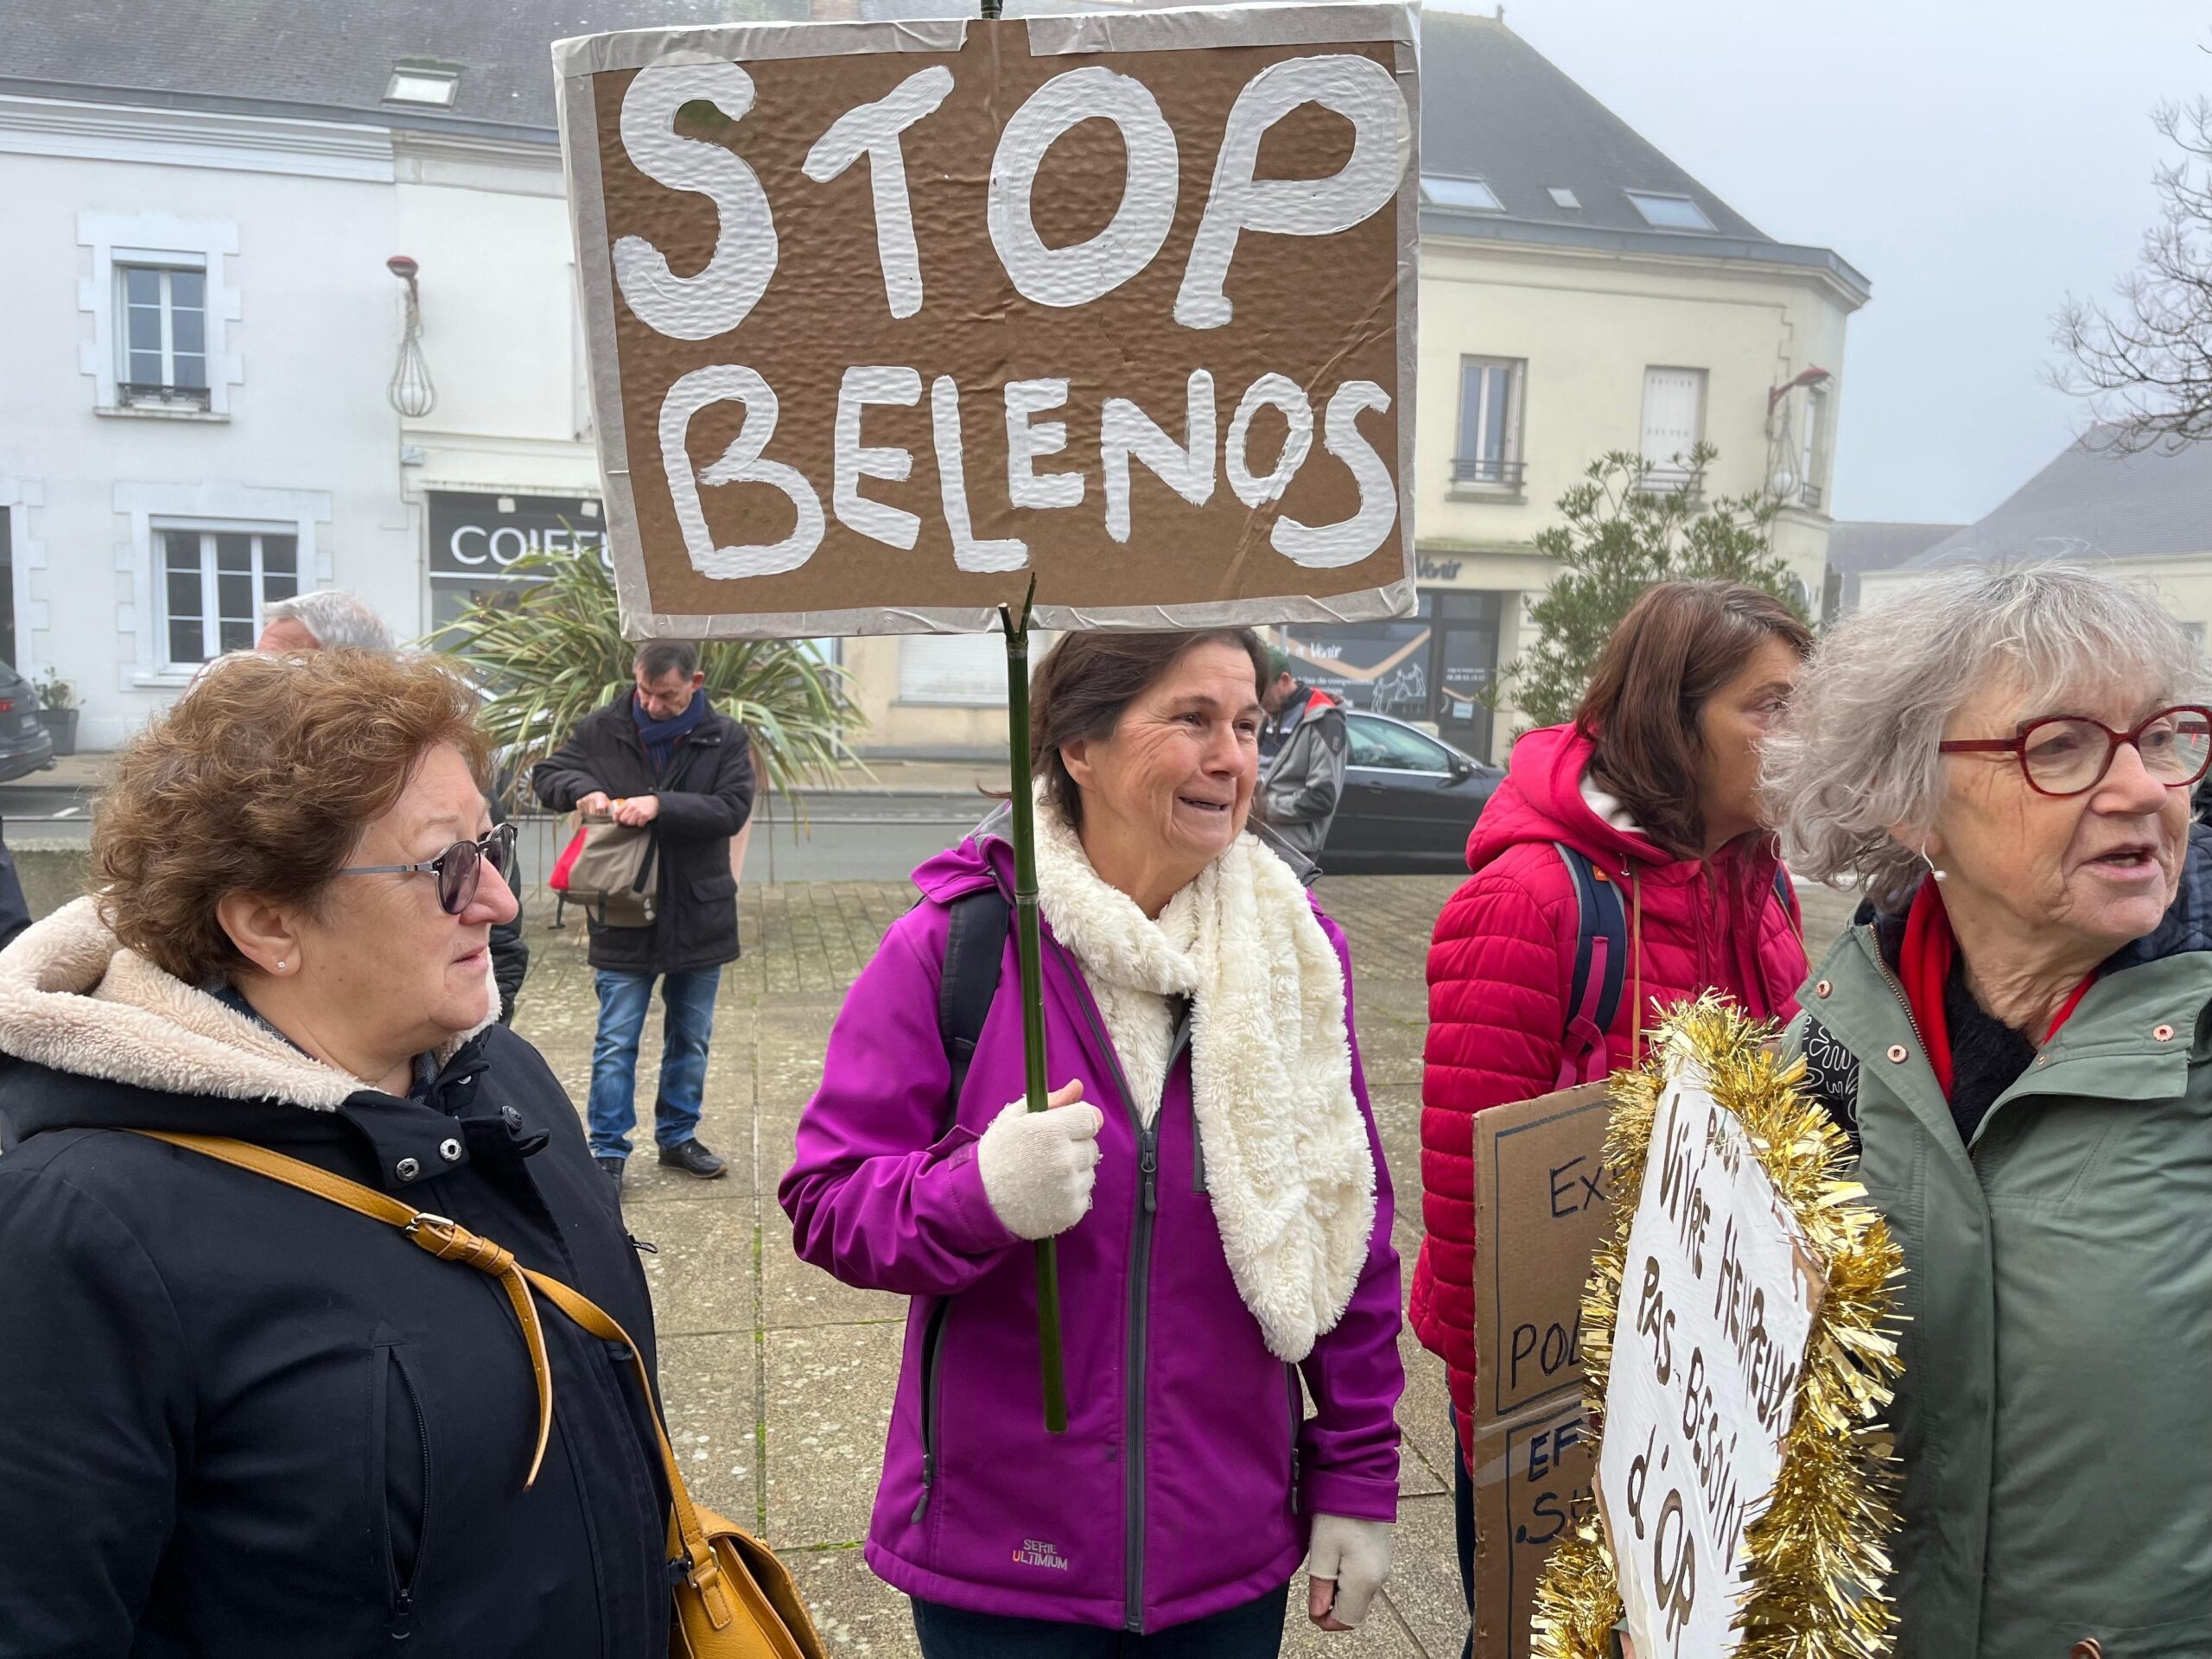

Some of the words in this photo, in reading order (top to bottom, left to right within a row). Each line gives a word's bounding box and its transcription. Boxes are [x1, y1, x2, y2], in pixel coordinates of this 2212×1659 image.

[612, 54, 1410, 340] STOP
[658, 364, 1397, 580] BELENOS
[1637, 1256, 1675, 1386] PAS
[1012, 1550, 1068, 1571] ULTIMIUM
[1023, 1539, 1058, 1554] SERIE
